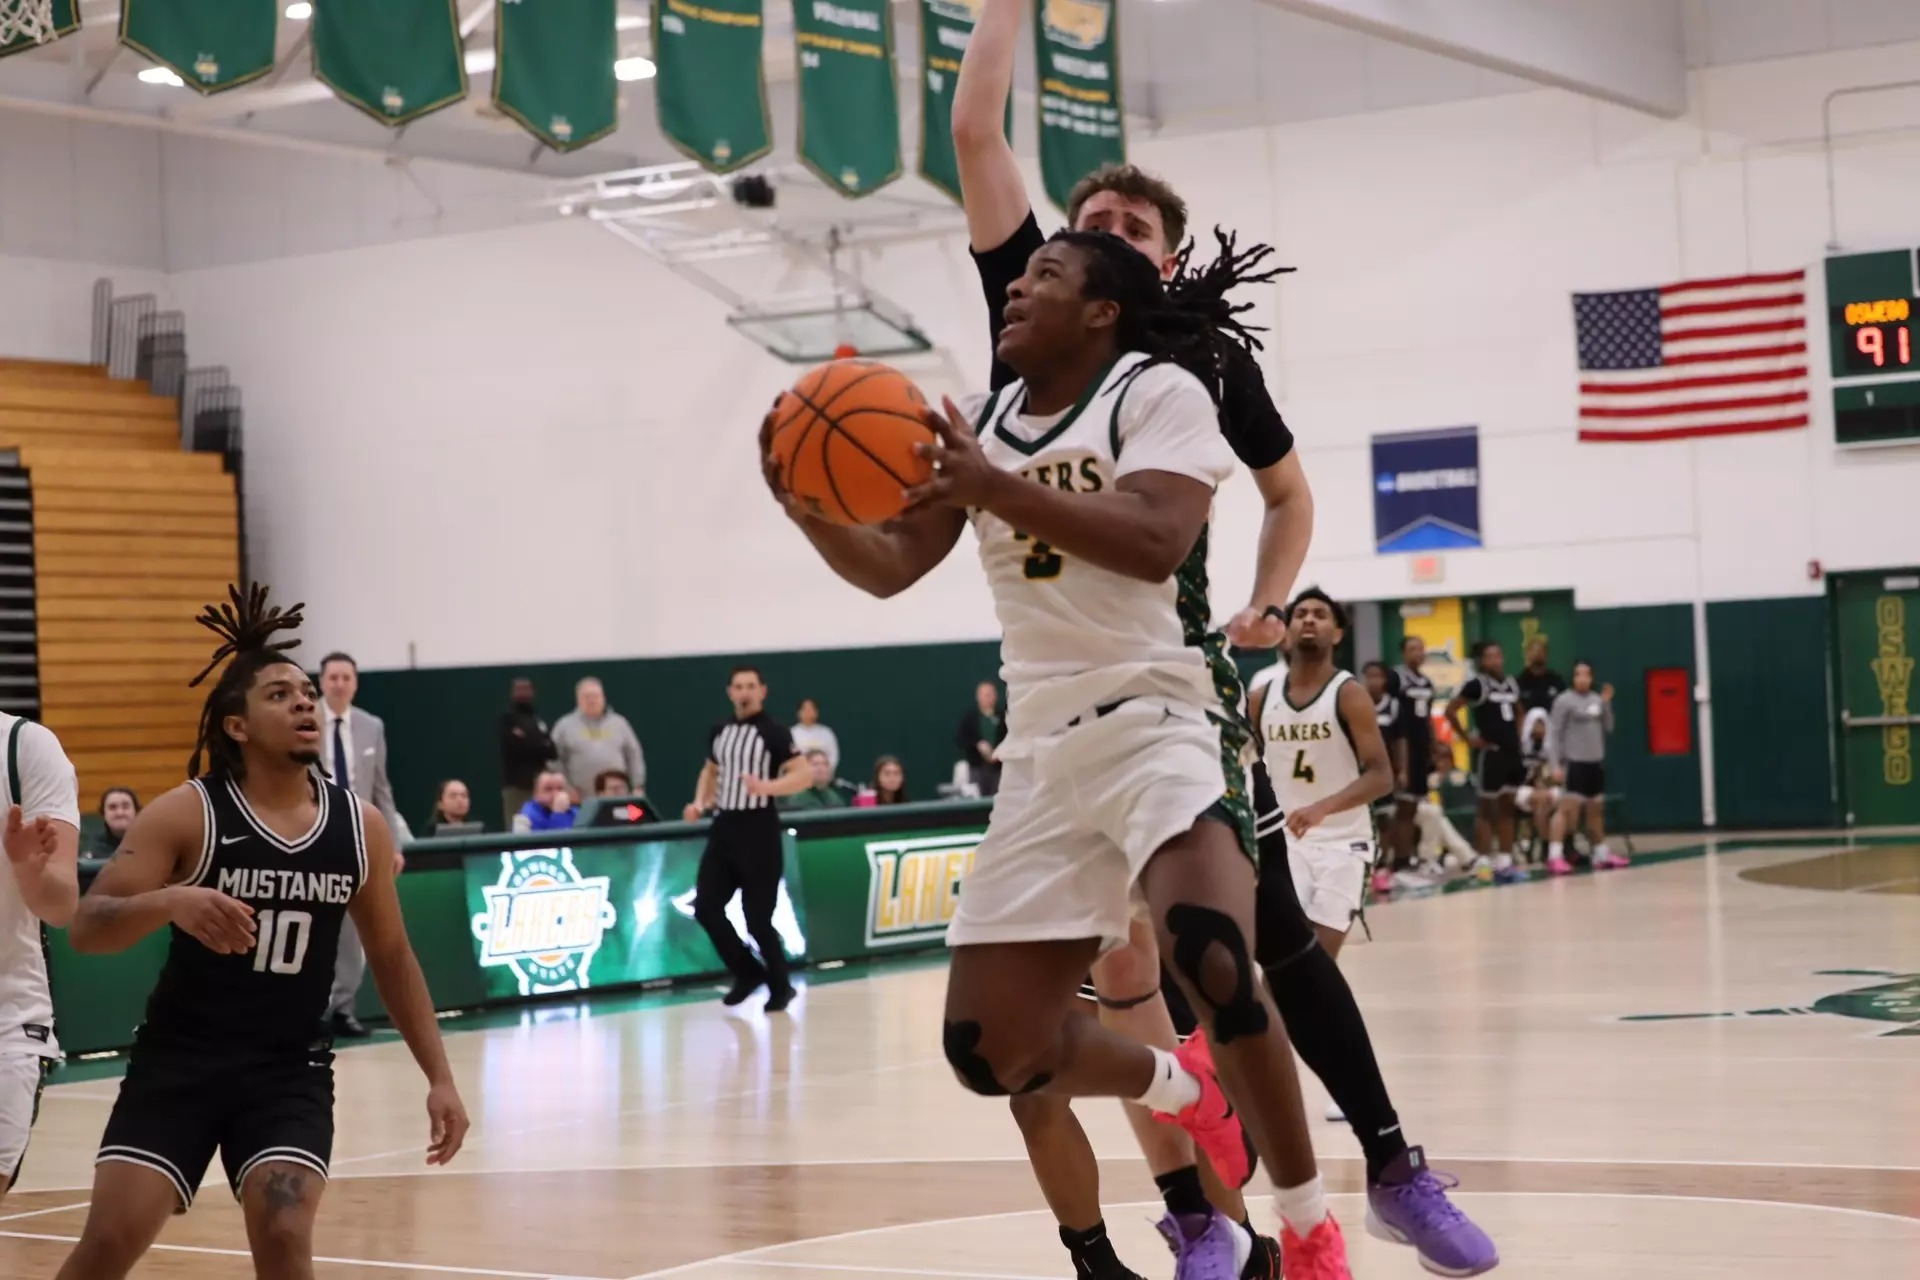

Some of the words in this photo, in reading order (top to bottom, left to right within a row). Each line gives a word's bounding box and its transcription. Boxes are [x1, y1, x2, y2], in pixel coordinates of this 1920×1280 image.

[1857, 326, 1911, 367] 91
[1021, 456, 1103, 493] ERS
[1268, 721, 1332, 742] LAKERS
[1292, 749, 1315, 784] 4
[216, 867, 353, 905] MUSTANGS
[877, 850, 977, 929] LAKE
[252, 909, 313, 975] 10
